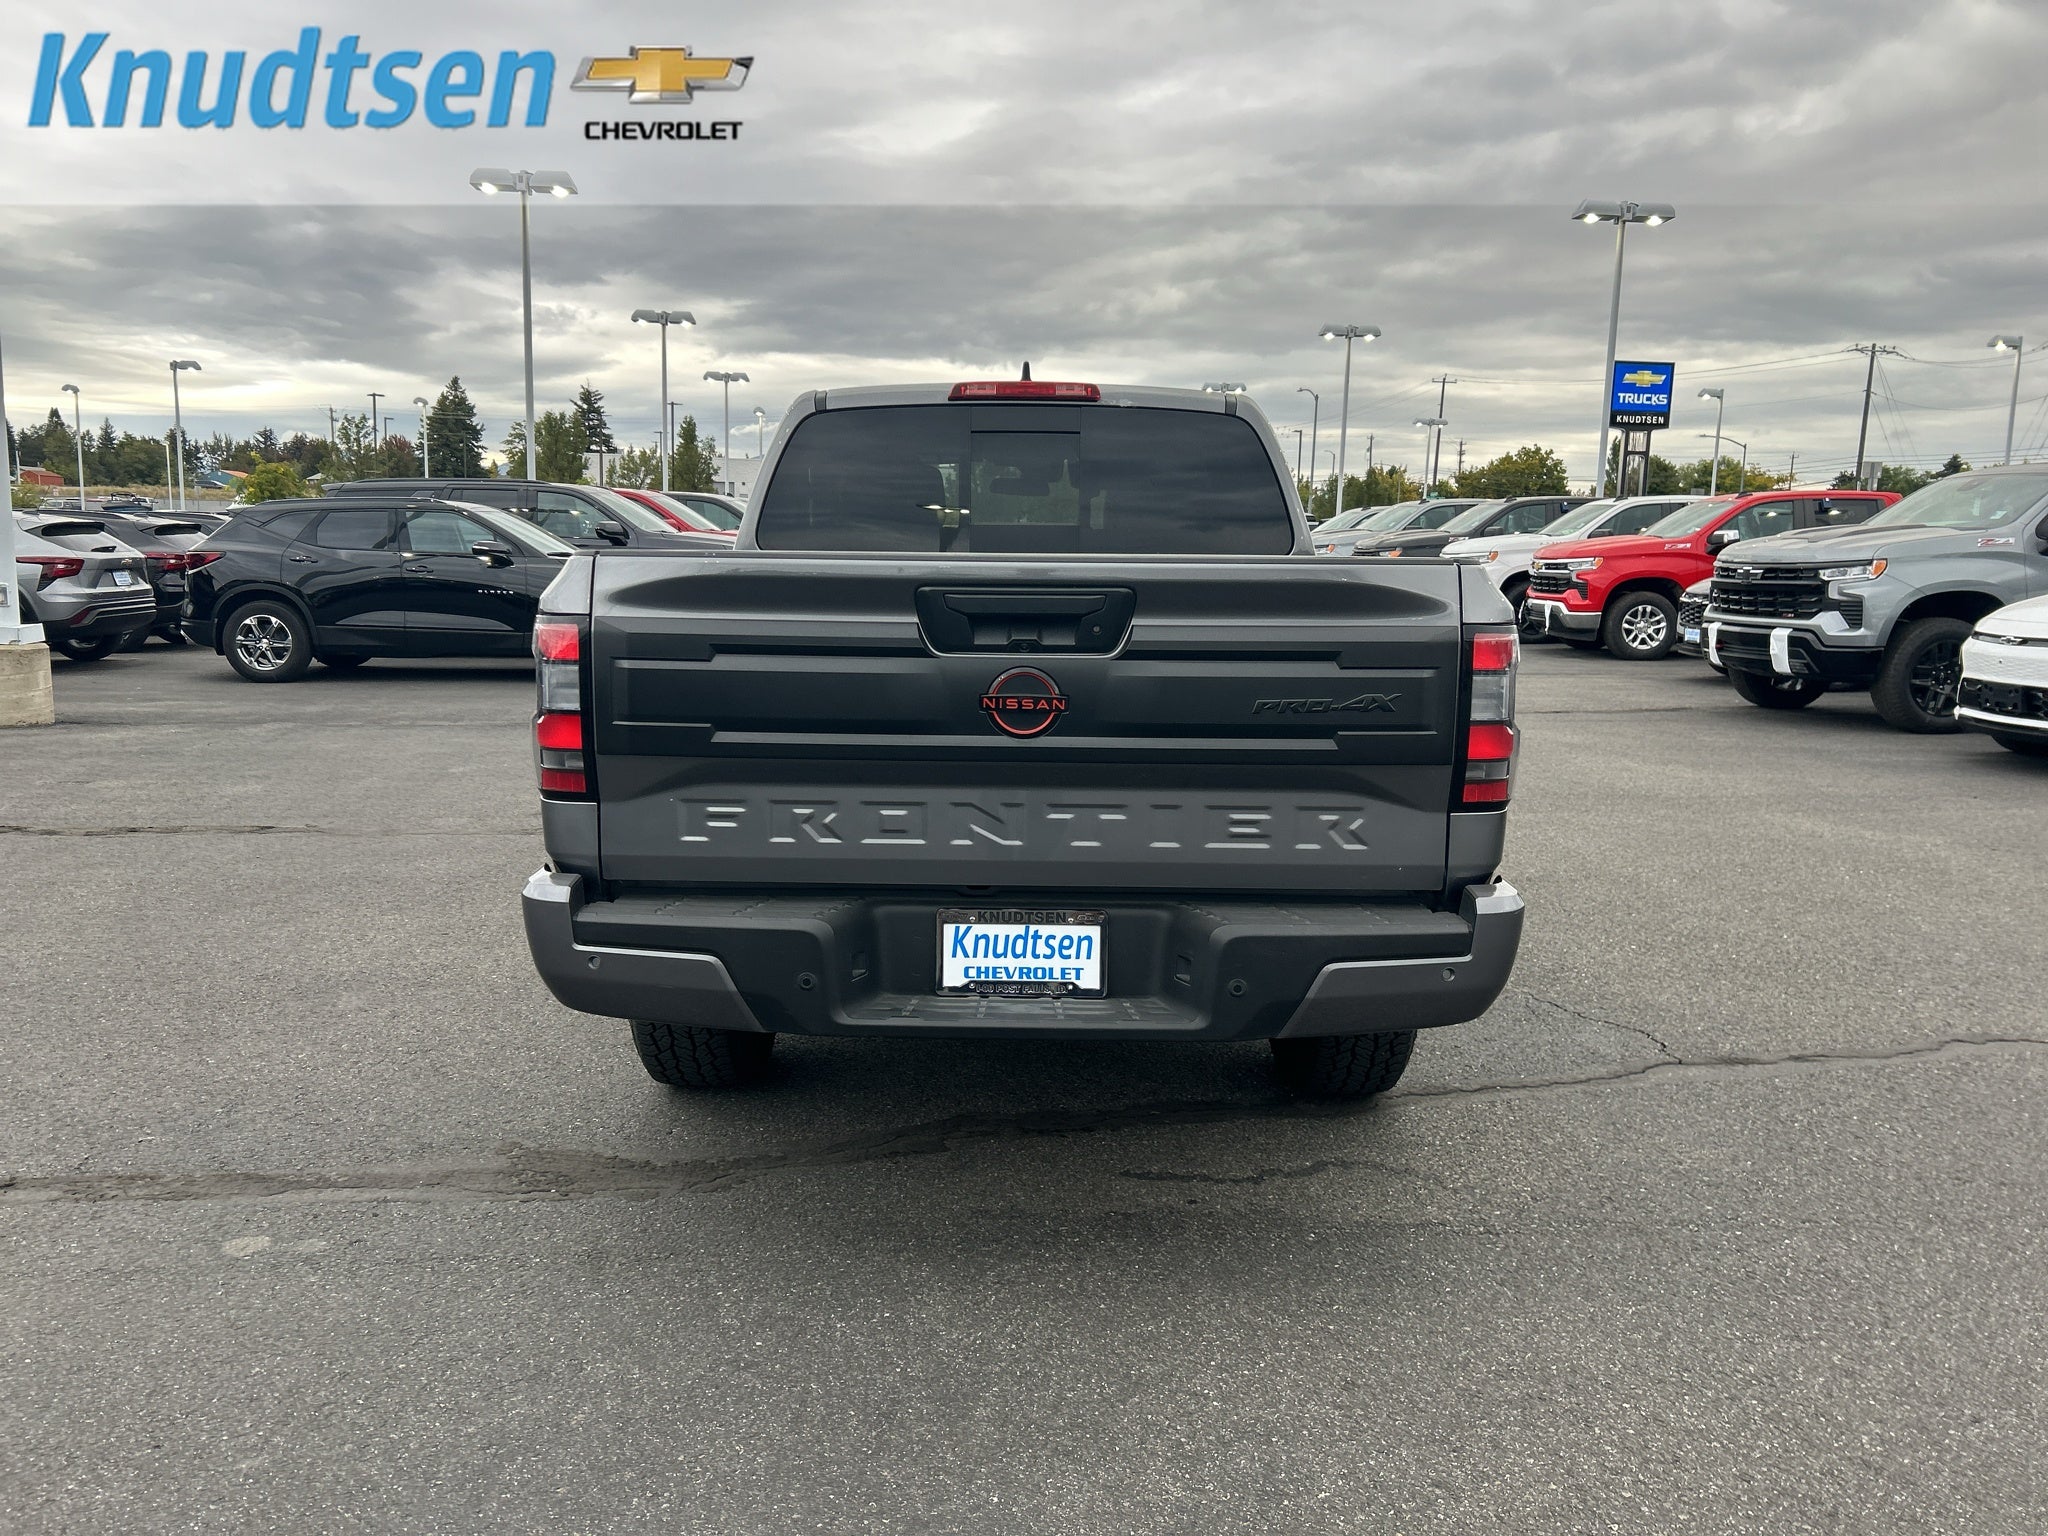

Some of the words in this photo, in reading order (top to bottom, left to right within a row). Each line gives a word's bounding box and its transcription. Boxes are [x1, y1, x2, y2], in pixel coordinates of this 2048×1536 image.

[1617, 392, 1668, 405] TRUCKS
[1616, 415, 1664, 424] KNUDTSEN
[982, 698, 1065, 710] NISSAN
[678, 800, 1368, 850] FRONTIER
[977, 911, 1067, 923] KNUDTSEN
[951, 925, 1094, 960] Knudtsen
[963, 966, 1084, 981] CHEVROLET
[995, 984, 1020, 993] POST
